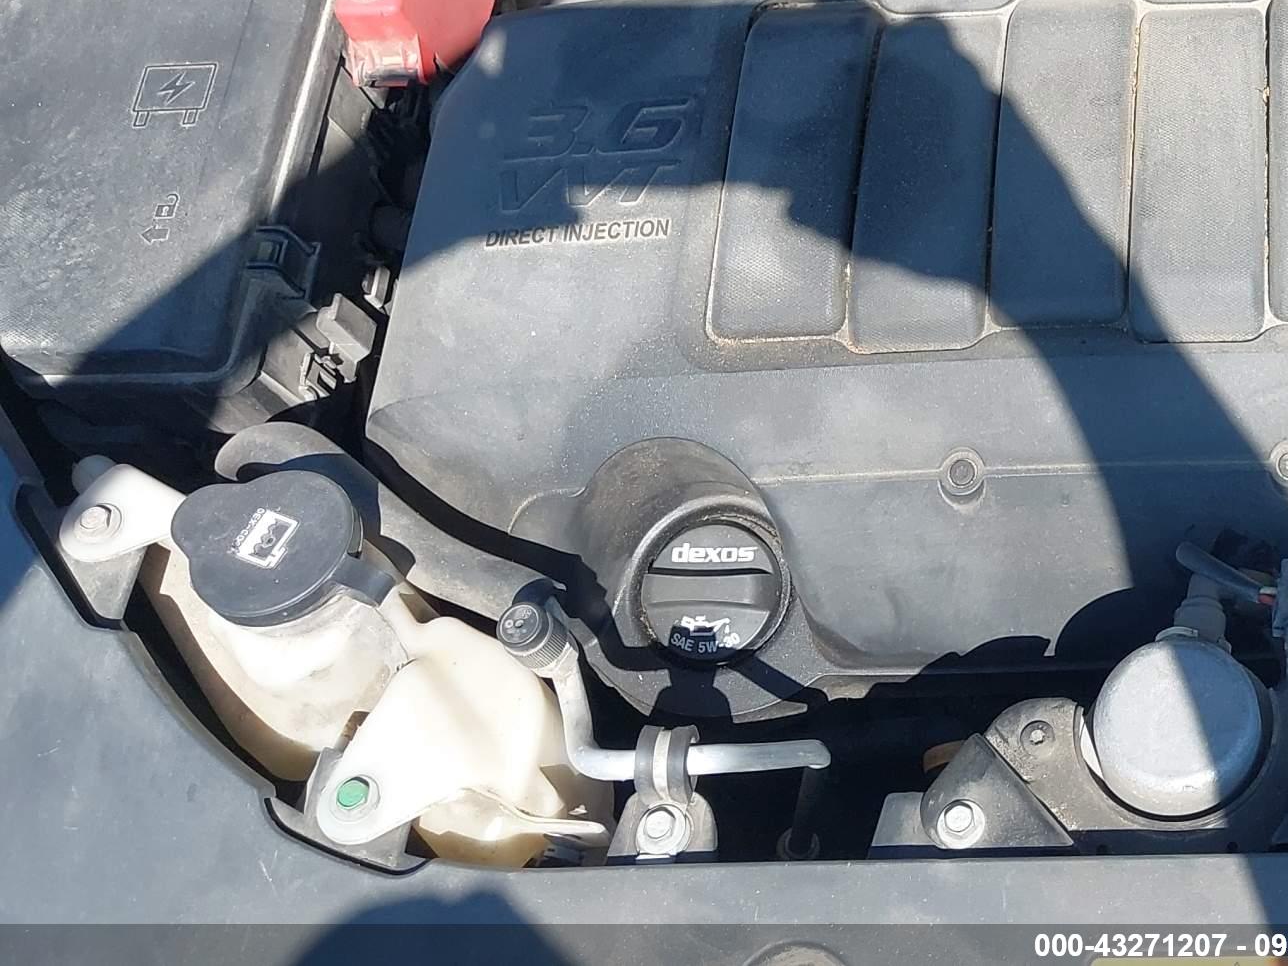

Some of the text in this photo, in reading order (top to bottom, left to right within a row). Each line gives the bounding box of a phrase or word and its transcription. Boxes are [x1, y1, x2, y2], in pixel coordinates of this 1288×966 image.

[502, 98, 692, 163] 3.6
[498, 158, 682, 215] VVT
[485, 218, 671, 248] DIRECT INJECTION
[671, 542, 759, 563] dexos
[670, 631, 741, 654] SAE 5W-30
